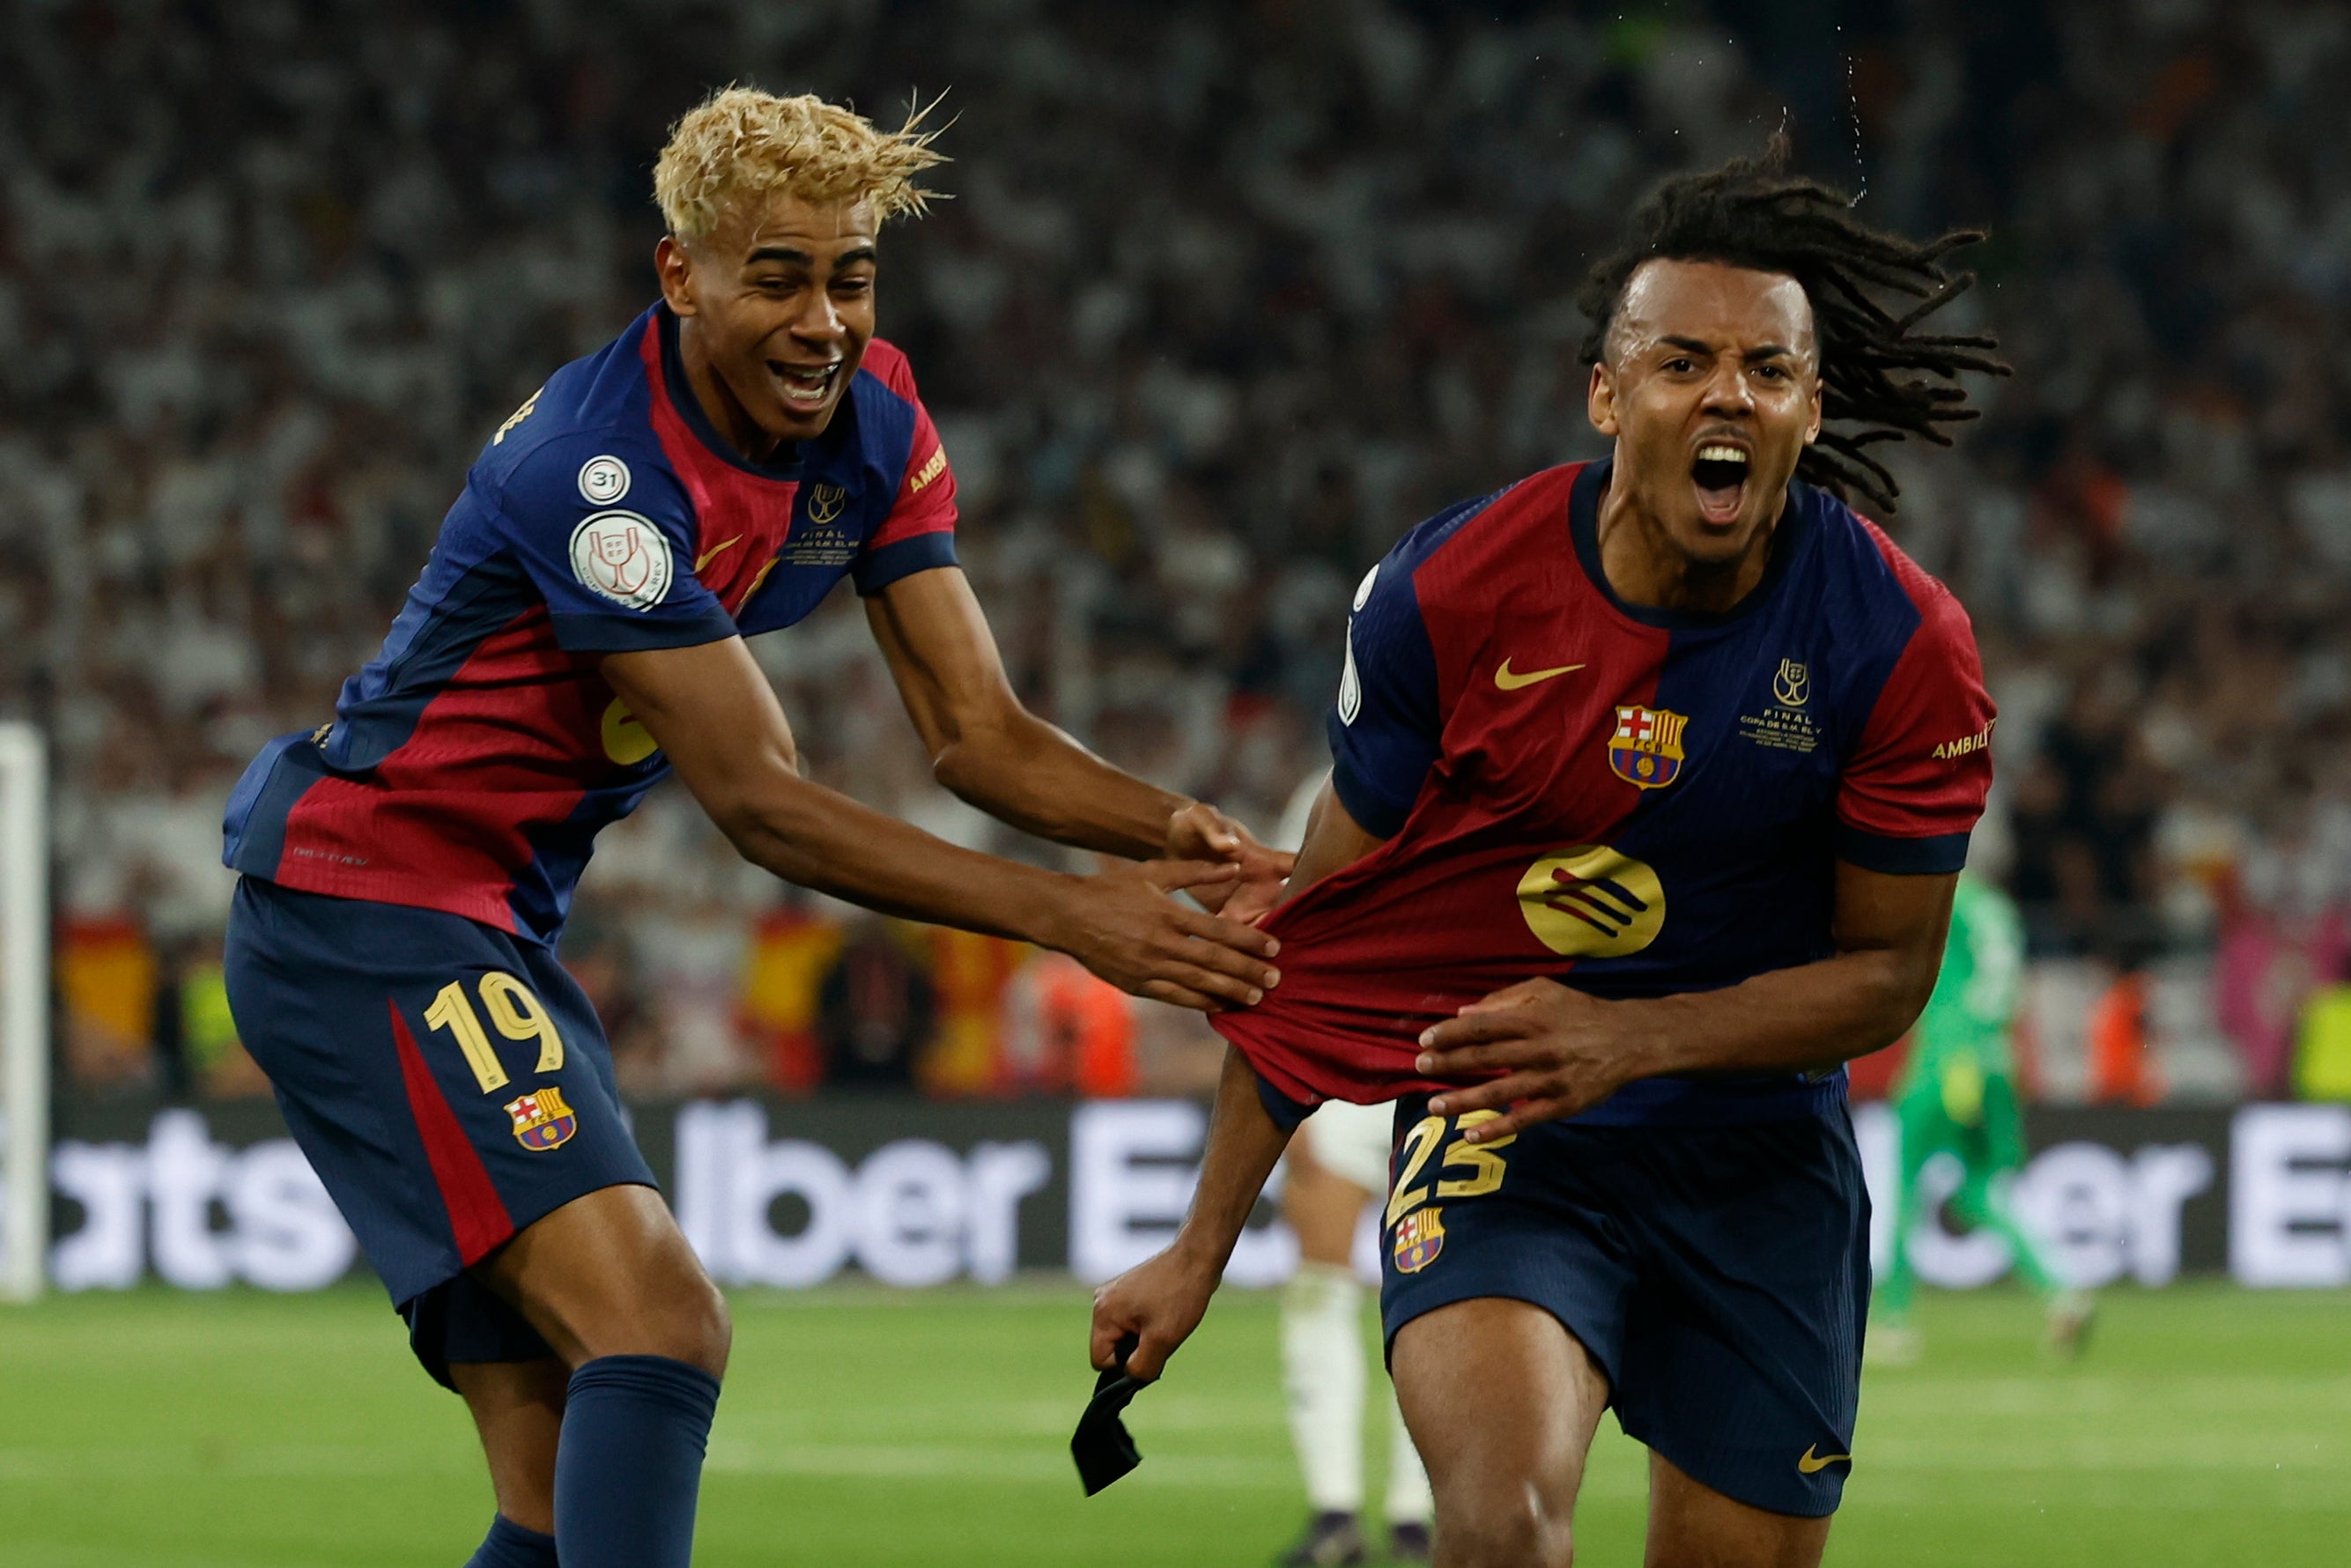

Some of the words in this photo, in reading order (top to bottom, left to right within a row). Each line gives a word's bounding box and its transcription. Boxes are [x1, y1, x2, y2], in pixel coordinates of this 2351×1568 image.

[591, 471, 617, 488] 31
[1740, 715, 1765, 727] COPA
[1767, 720, 1780, 729] DE
[1763, 708, 1813, 725] FINAL
[1633, 739, 1663, 754] FCB
[423, 971, 565, 1095] 19
[529, 1111, 556, 1127] FCB
[1386, 1109, 1519, 1231] 23
